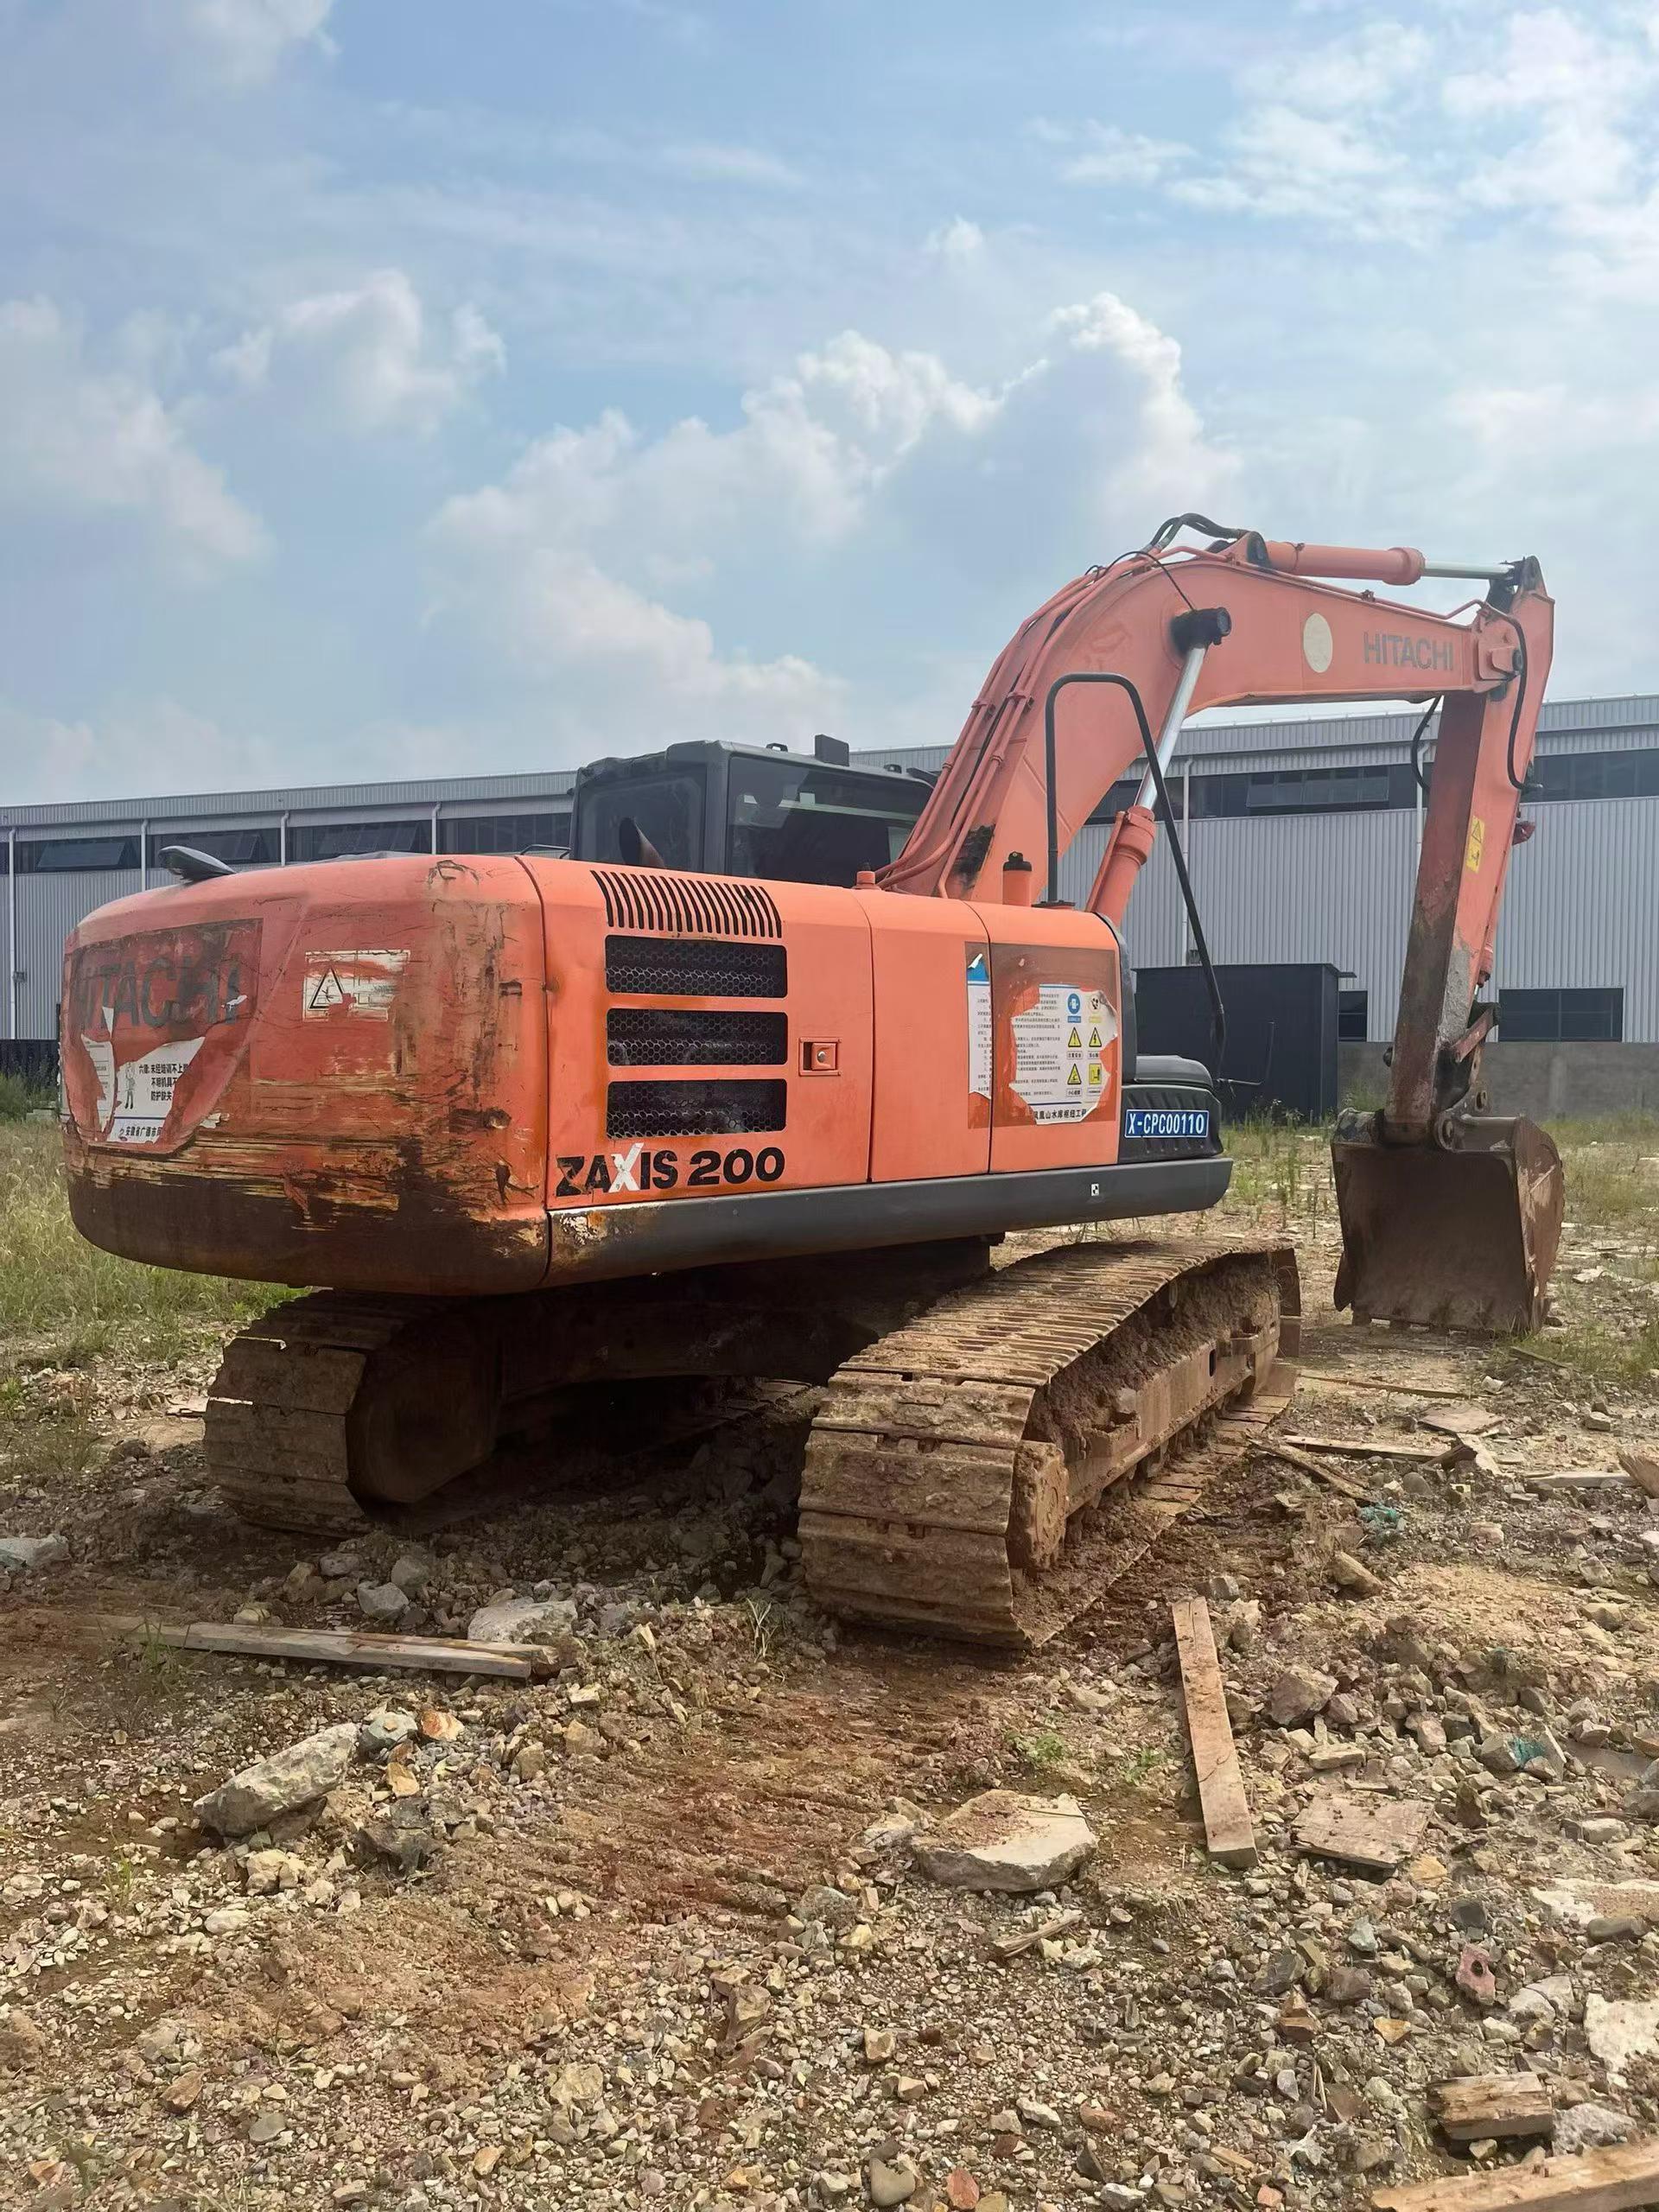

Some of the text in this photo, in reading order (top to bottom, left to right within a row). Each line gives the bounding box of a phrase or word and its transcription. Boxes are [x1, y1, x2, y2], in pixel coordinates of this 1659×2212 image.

[1363, 631, 1453, 671] HITACHI
[1128, 1113, 1205, 1135] X-CPC00110
[556, 1142, 785, 1198] ZAXIS 200
